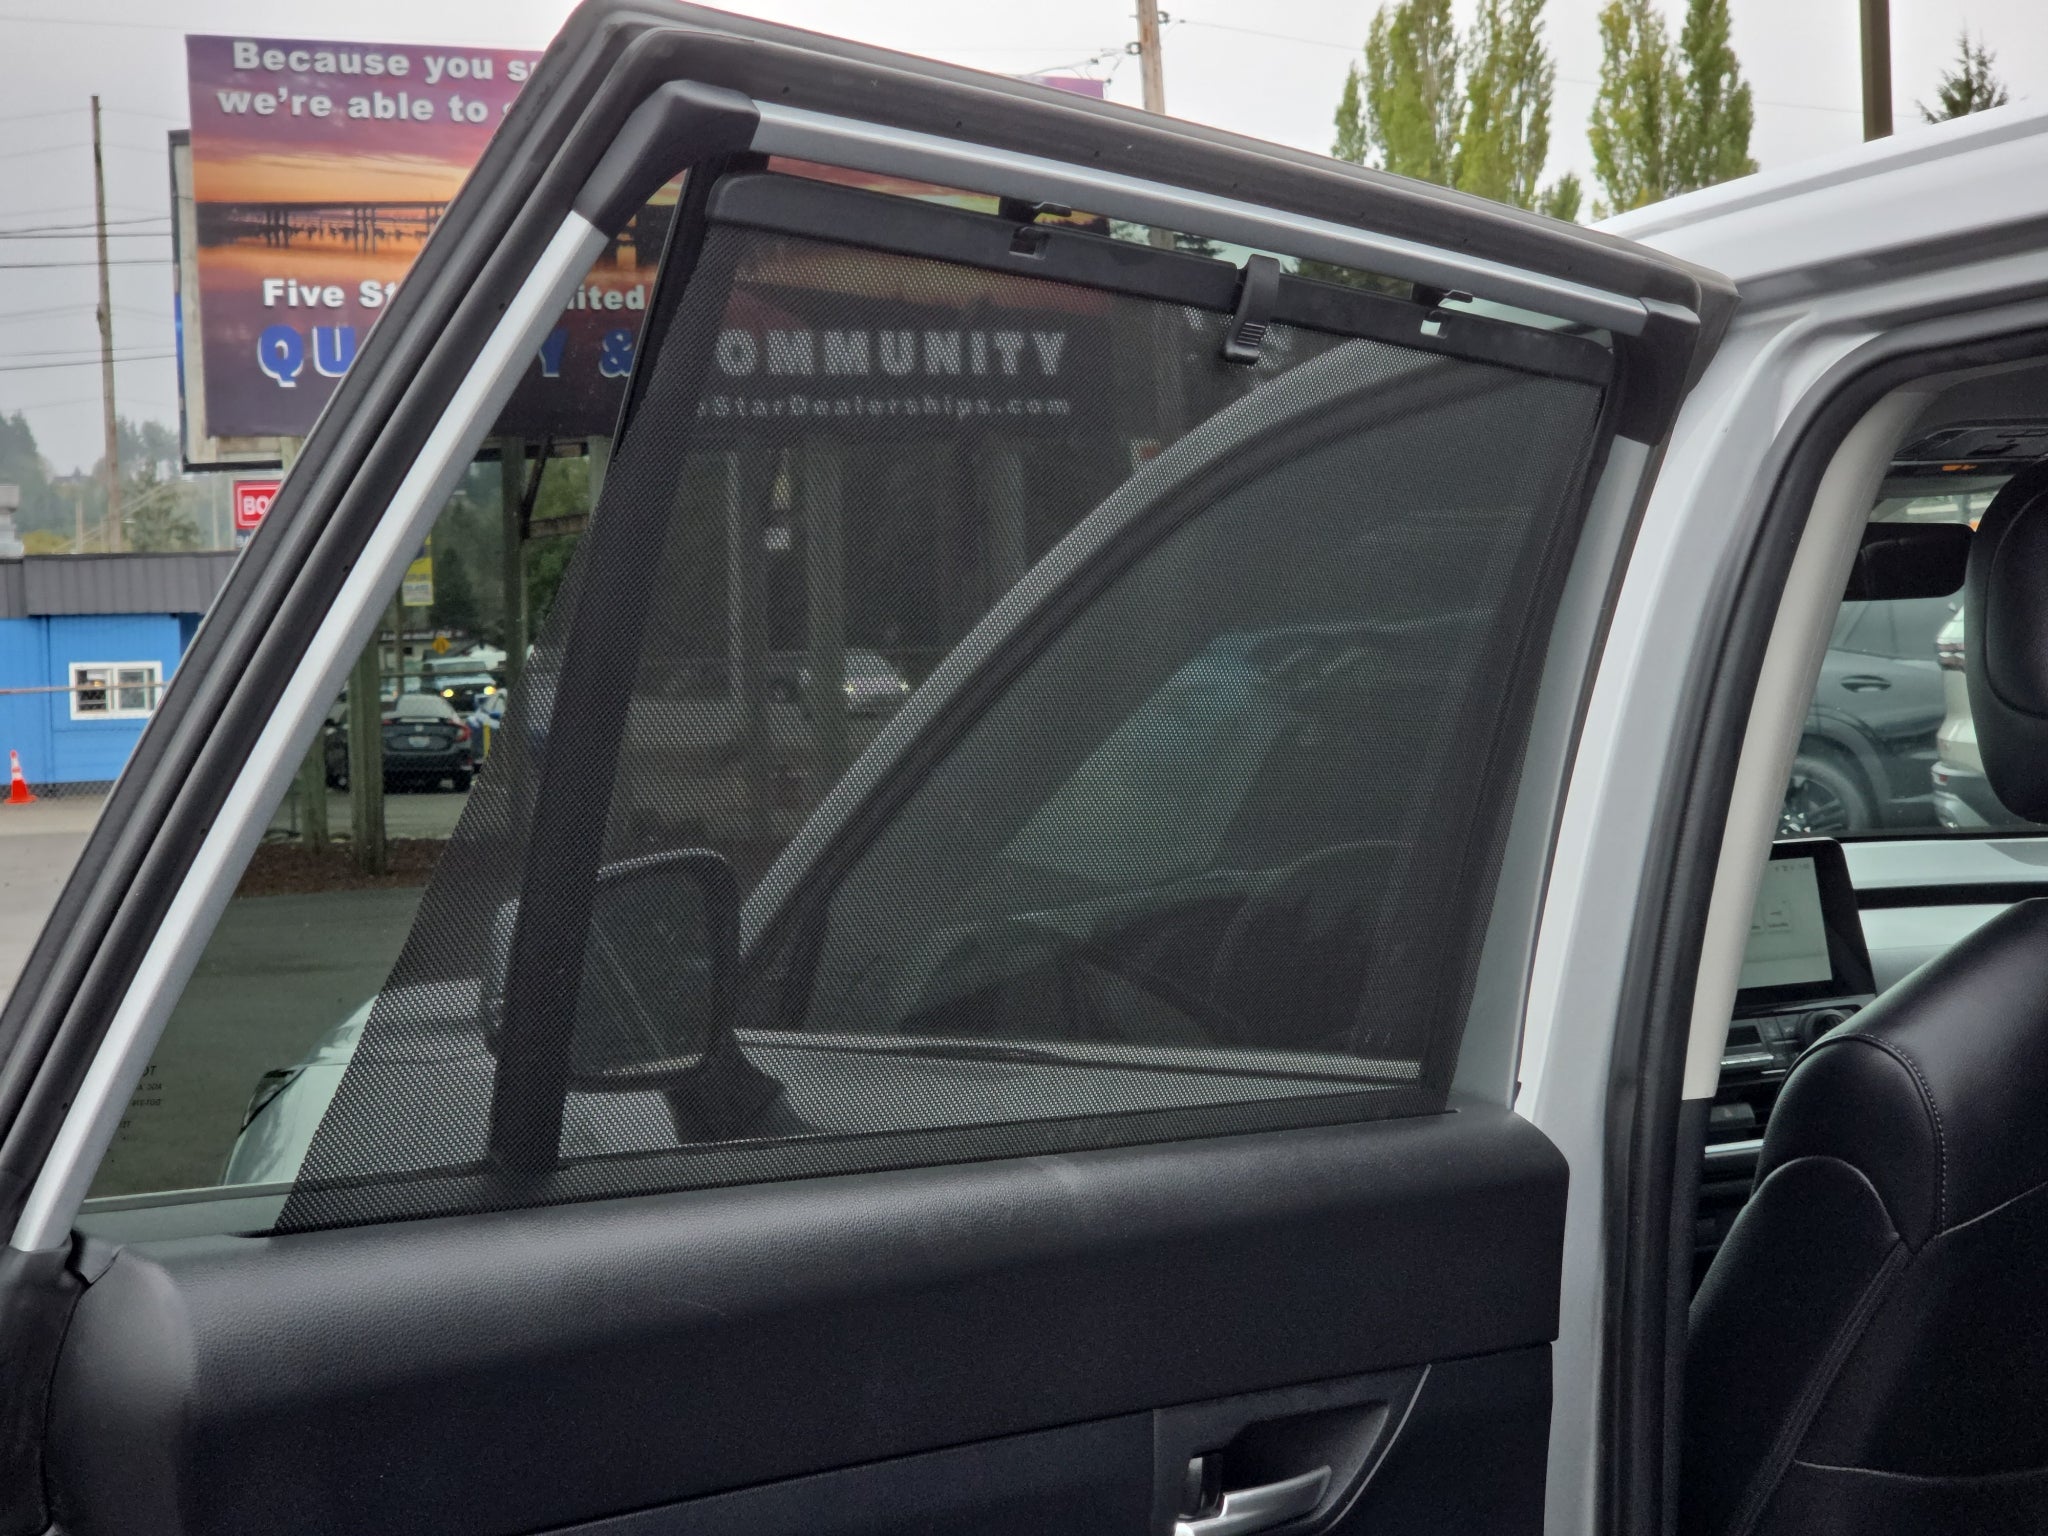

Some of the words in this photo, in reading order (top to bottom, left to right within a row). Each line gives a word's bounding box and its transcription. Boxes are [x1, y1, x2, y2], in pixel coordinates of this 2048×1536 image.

[233, 41, 410, 76] Because
[424, 55, 493, 84] you
[217, 87, 332, 117] we're
[348, 91, 434, 121] able
[449, 96, 488, 123] to
[263, 278, 345, 308] Five
[359, 280, 399, 308] St
[257, 325, 357, 388] QU
[599, 328, 635, 378] &
[716, 329, 1066, 376] OMMUNITY
[243, 495, 270, 515] BO
